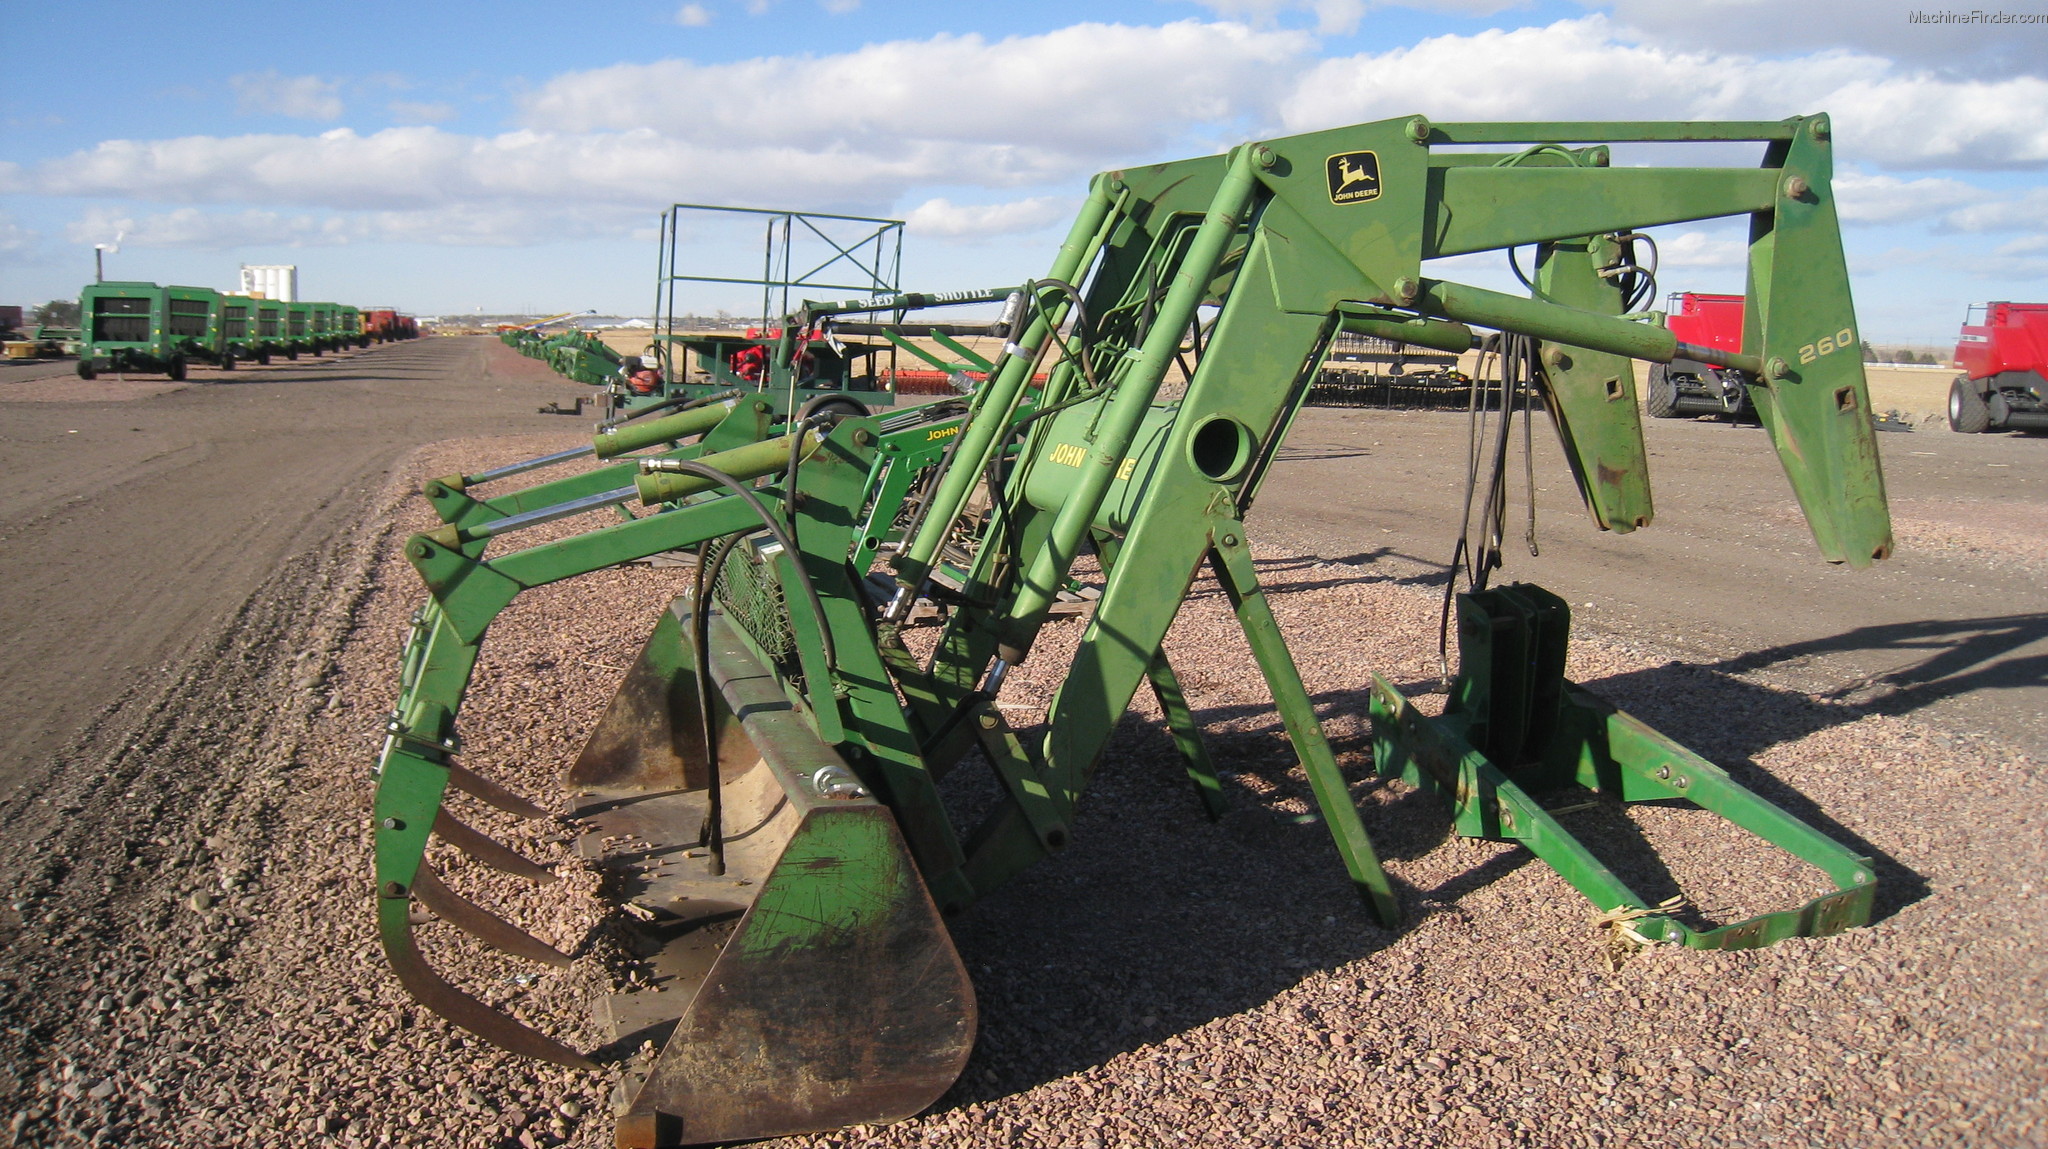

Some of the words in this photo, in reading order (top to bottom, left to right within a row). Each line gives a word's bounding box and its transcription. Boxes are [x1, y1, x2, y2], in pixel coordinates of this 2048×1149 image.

[1334, 193, 1354, 201] JOHN
[1354, 188, 1378, 198] DEERE
[858, 295, 895, 308] SEED
[934, 288, 994, 302] SHUTTLE
[1798, 327, 1853, 365] 260
[926, 426, 959, 441] JOHN
[1049, 442, 1088, 468] JOHN
